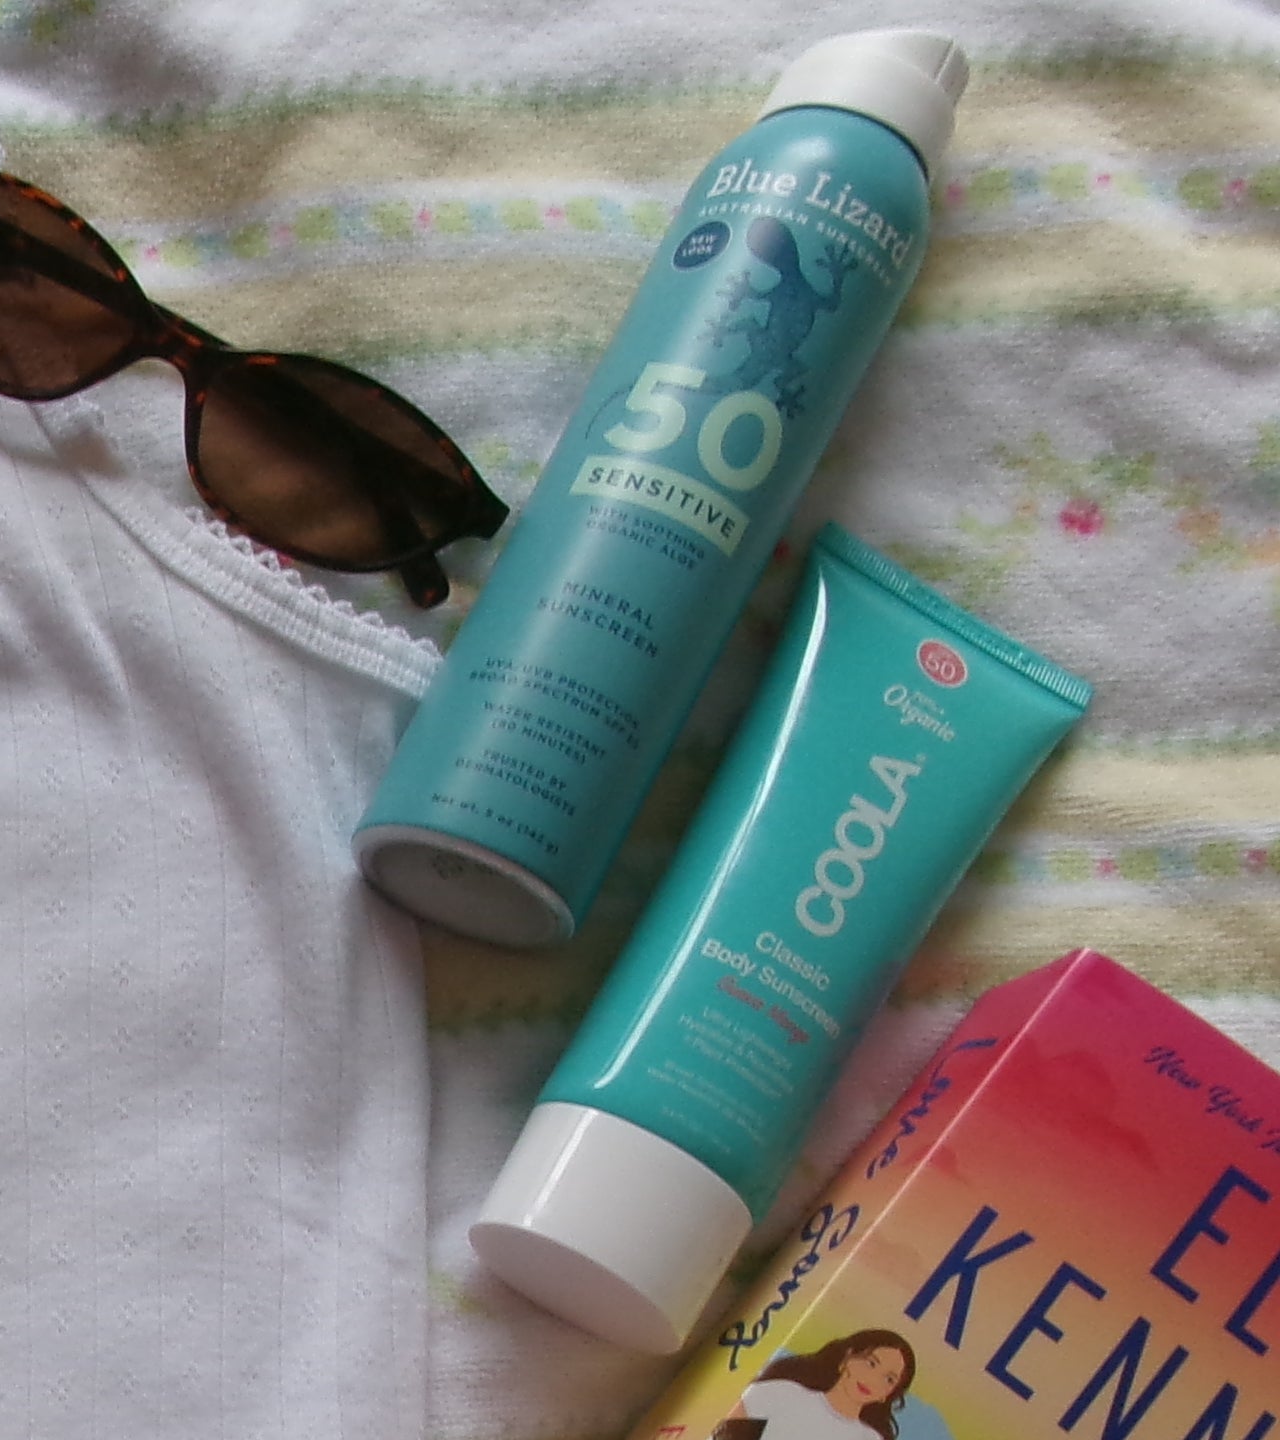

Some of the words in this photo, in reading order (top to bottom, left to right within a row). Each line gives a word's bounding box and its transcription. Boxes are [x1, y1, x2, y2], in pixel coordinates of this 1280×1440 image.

[705, 158, 798, 199] Blue
[805, 171, 915, 271] Lizard
[602, 361, 784, 492] 50
[587, 466, 737, 539] SENSITIVE
[537, 597, 659, 658] SUNSCREEN
[562, 581, 654, 631] MINERAL
[925, 651, 956, 680] 50
[794, 755, 923, 938] COOLA
[701, 938, 757, 977] Body
[758, 966, 841, 1040] Sunscreen
[755, 931, 830, 991] Classic
[1143, 1045, 1201, 1089] New
[1205, 1085, 1265, 1133] York
[717, 1203, 861, 1372] Song
